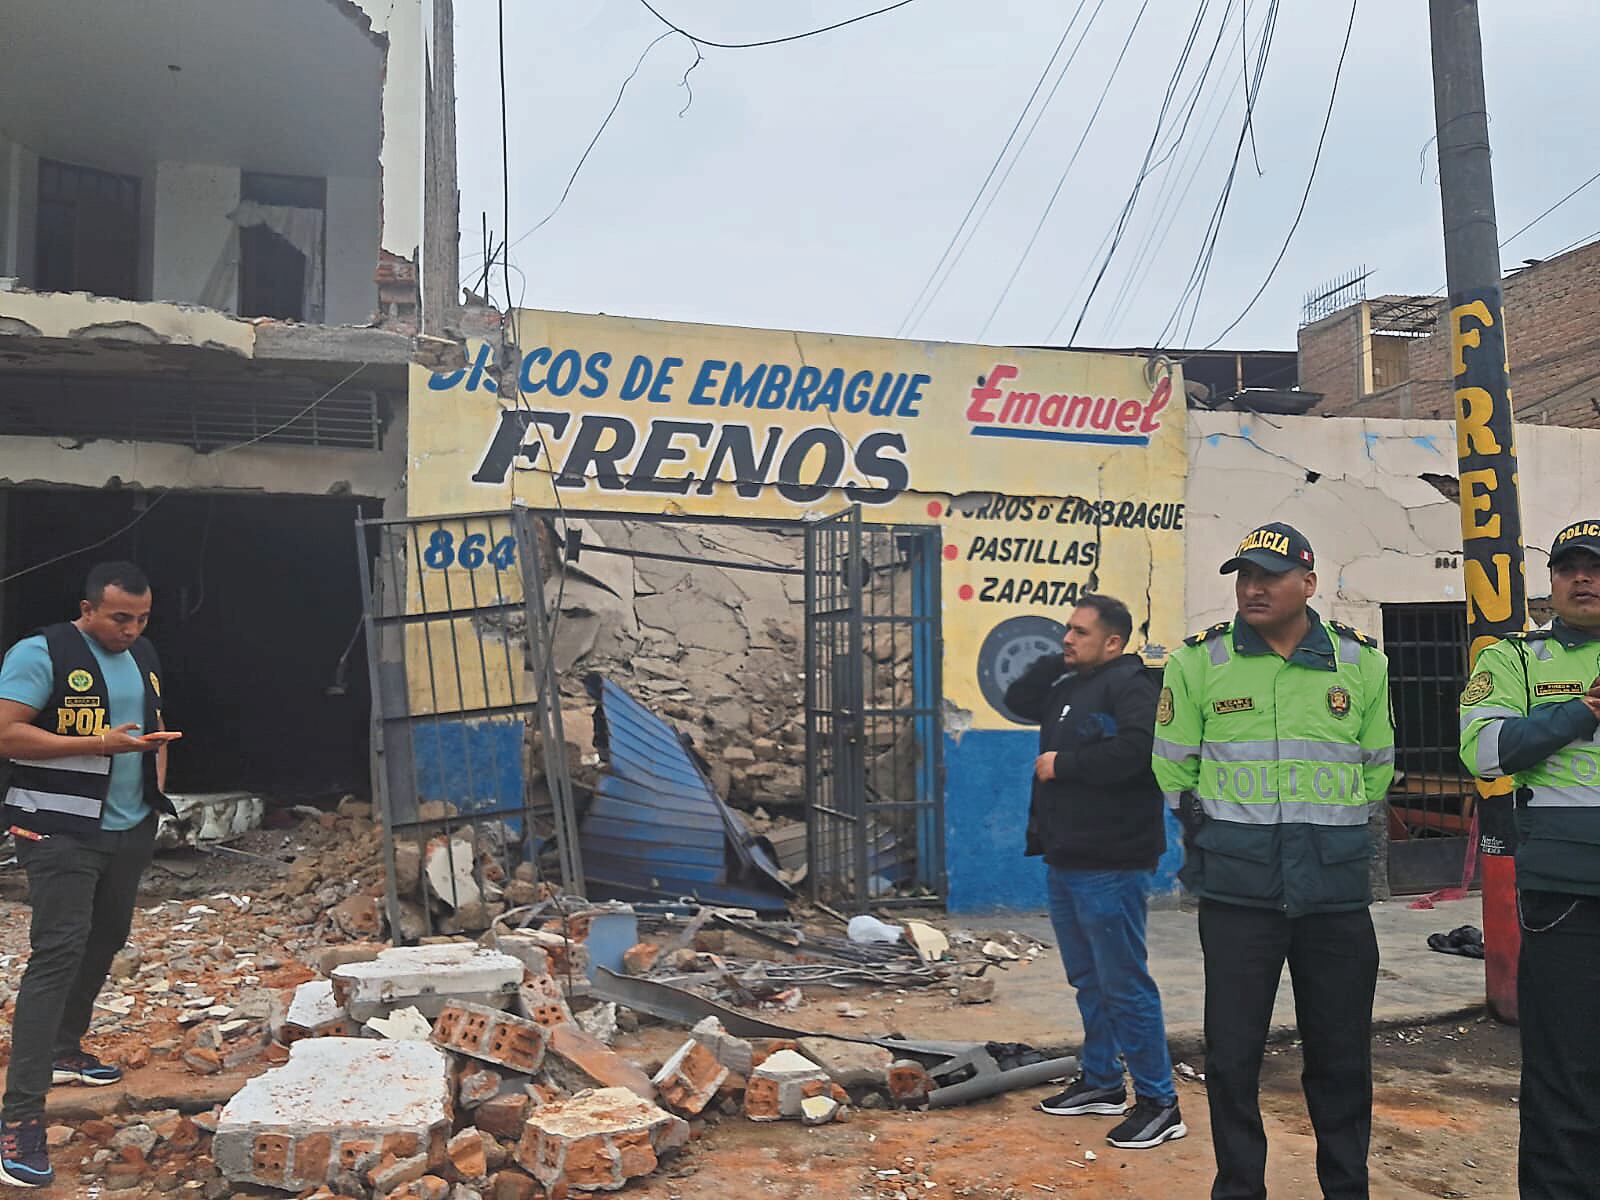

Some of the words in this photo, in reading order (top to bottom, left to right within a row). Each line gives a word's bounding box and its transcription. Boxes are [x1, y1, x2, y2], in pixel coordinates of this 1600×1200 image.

[619, 354, 684, 403] DE
[688, 360, 931, 418] EMBRAGUE
[966, 364, 1172, 433] Emanuel
[471, 409, 910, 504] FRENOS
[1055, 499, 1185, 530] EMBRAGUE
[1559, 523, 1600, 545] POLIC
[423, 528, 517, 571] 864
[966, 536, 1097, 566] PASTILLAS
[1449, 299, 1516, 800] FREN
[57, 707, 110, 736] POL
